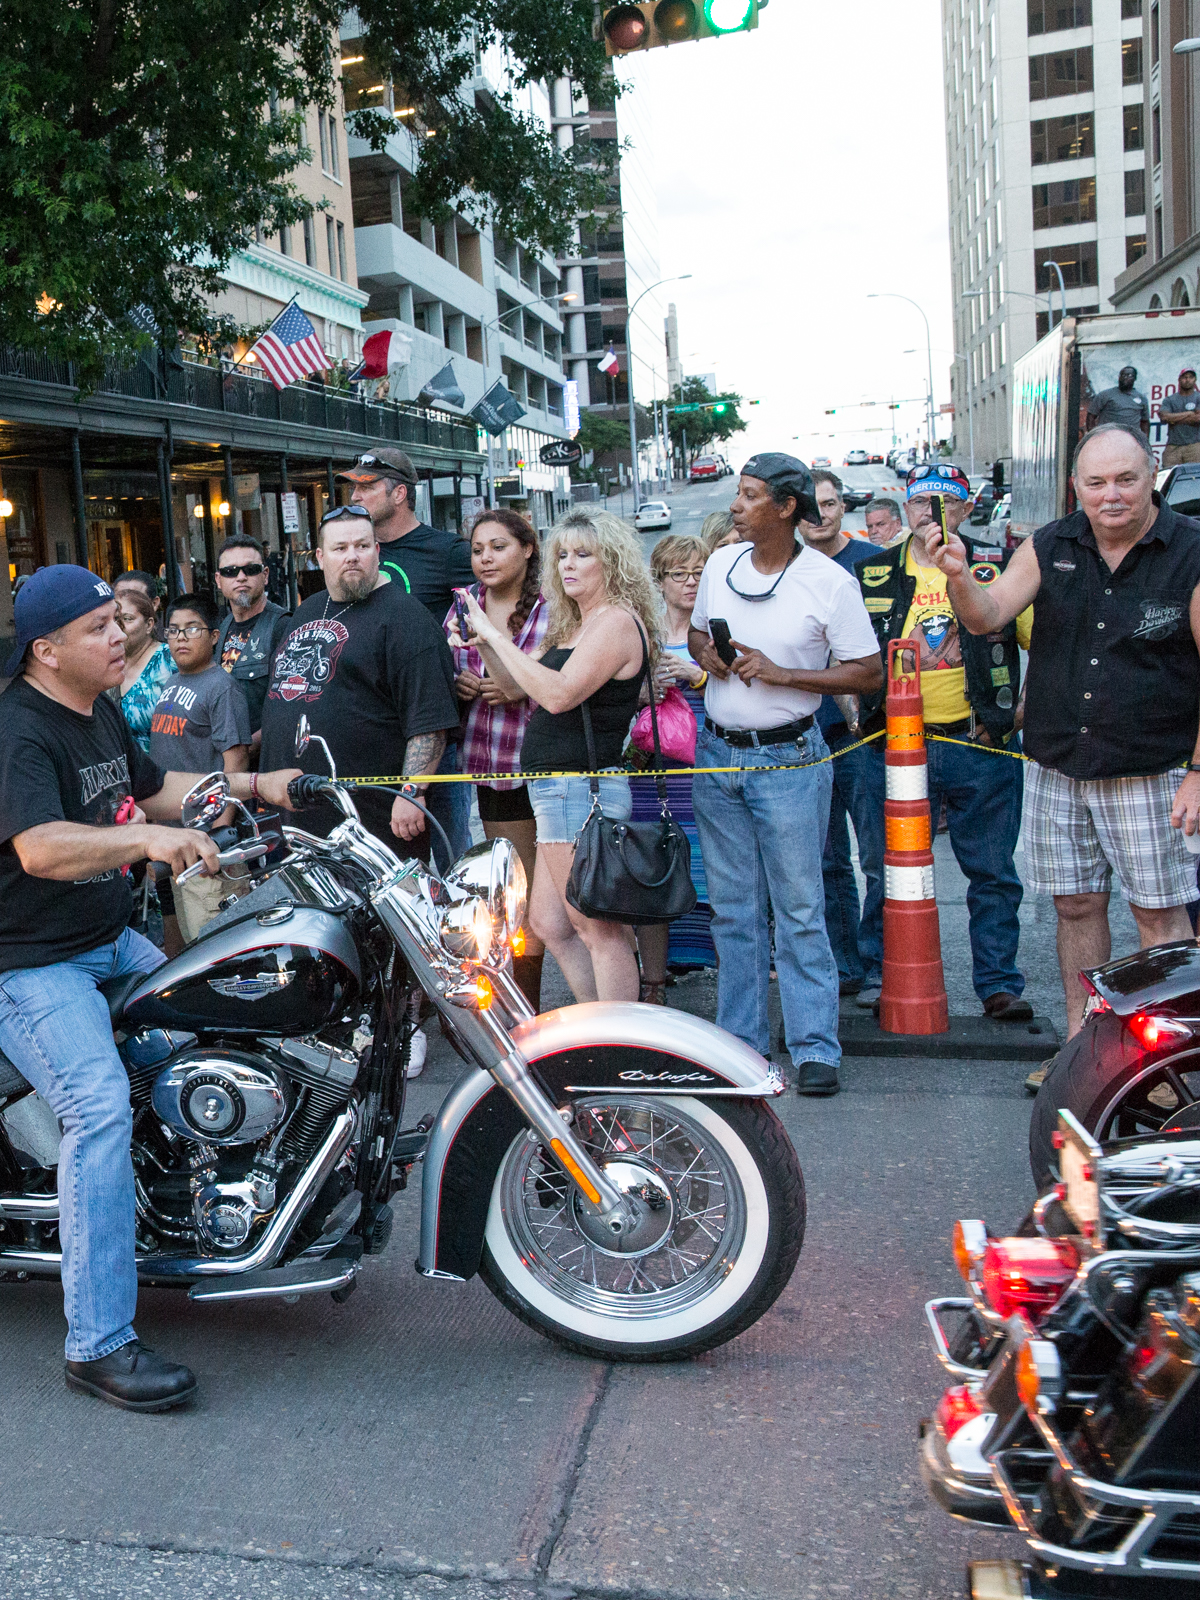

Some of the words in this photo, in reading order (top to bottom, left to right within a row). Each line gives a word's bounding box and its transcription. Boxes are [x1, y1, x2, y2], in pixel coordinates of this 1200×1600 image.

[909, 482, 942, 495] PUERTO
[942, 482, 961, 494] RICO
[173, 685, 197, 711] YOU
[617, 1069, 715, 1083] Deluxe
